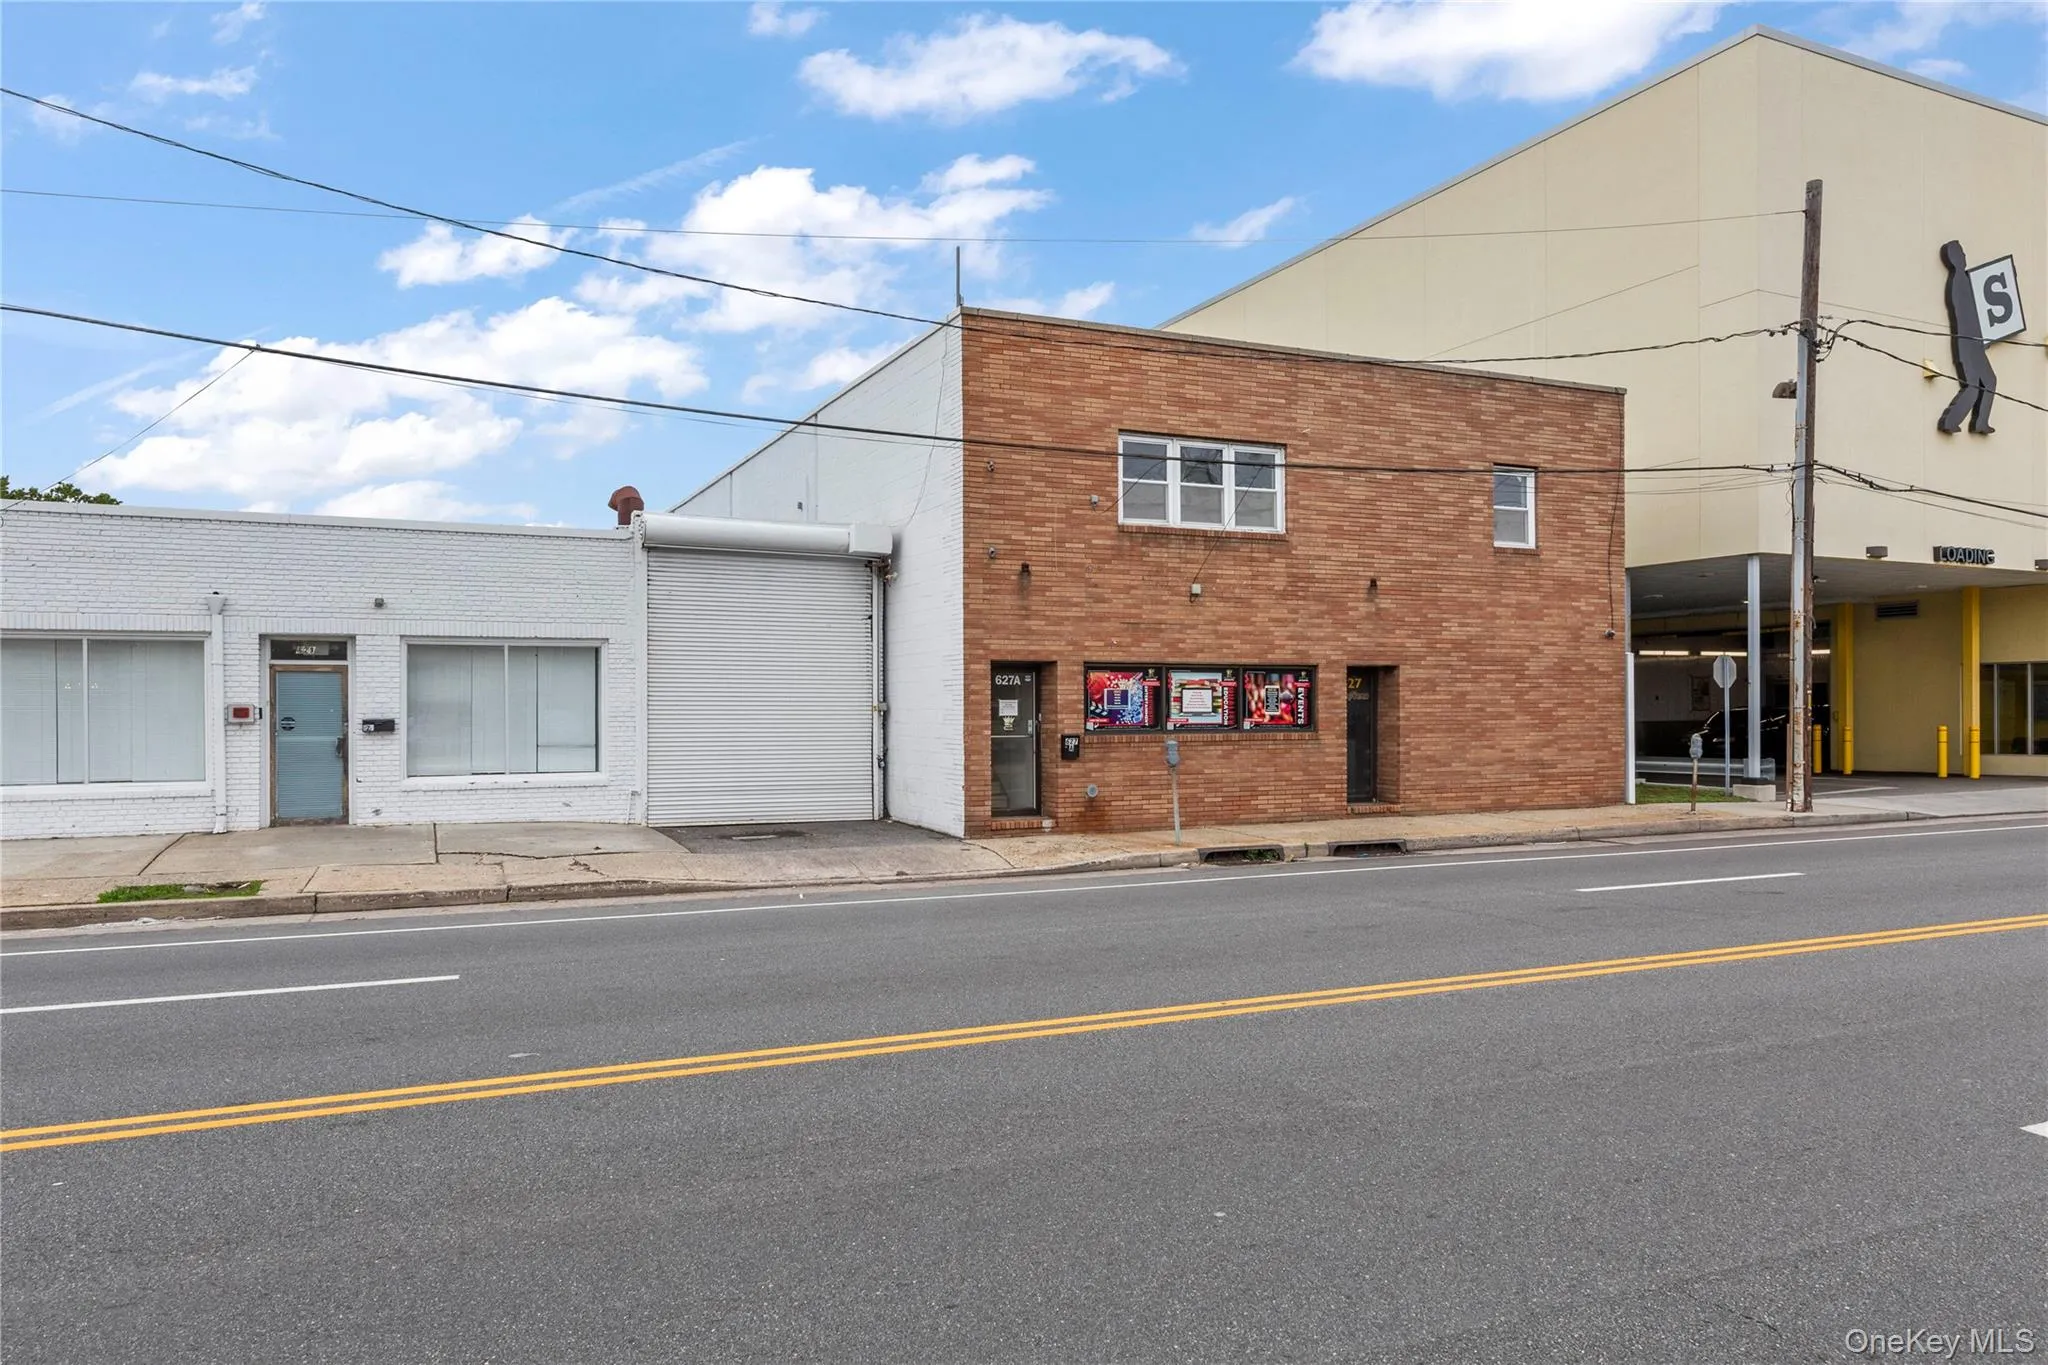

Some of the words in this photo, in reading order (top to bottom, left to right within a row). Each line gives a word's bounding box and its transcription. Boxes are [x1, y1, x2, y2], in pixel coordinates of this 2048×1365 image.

[1983, 272, 2013, 328] S
[1939, 545, 1995, 565] LOADING
[995, 674, 1021, 686] 627A
[1347, 678, 1363, 689] 27
[1297, 687, 1305, 725] EVENTS
